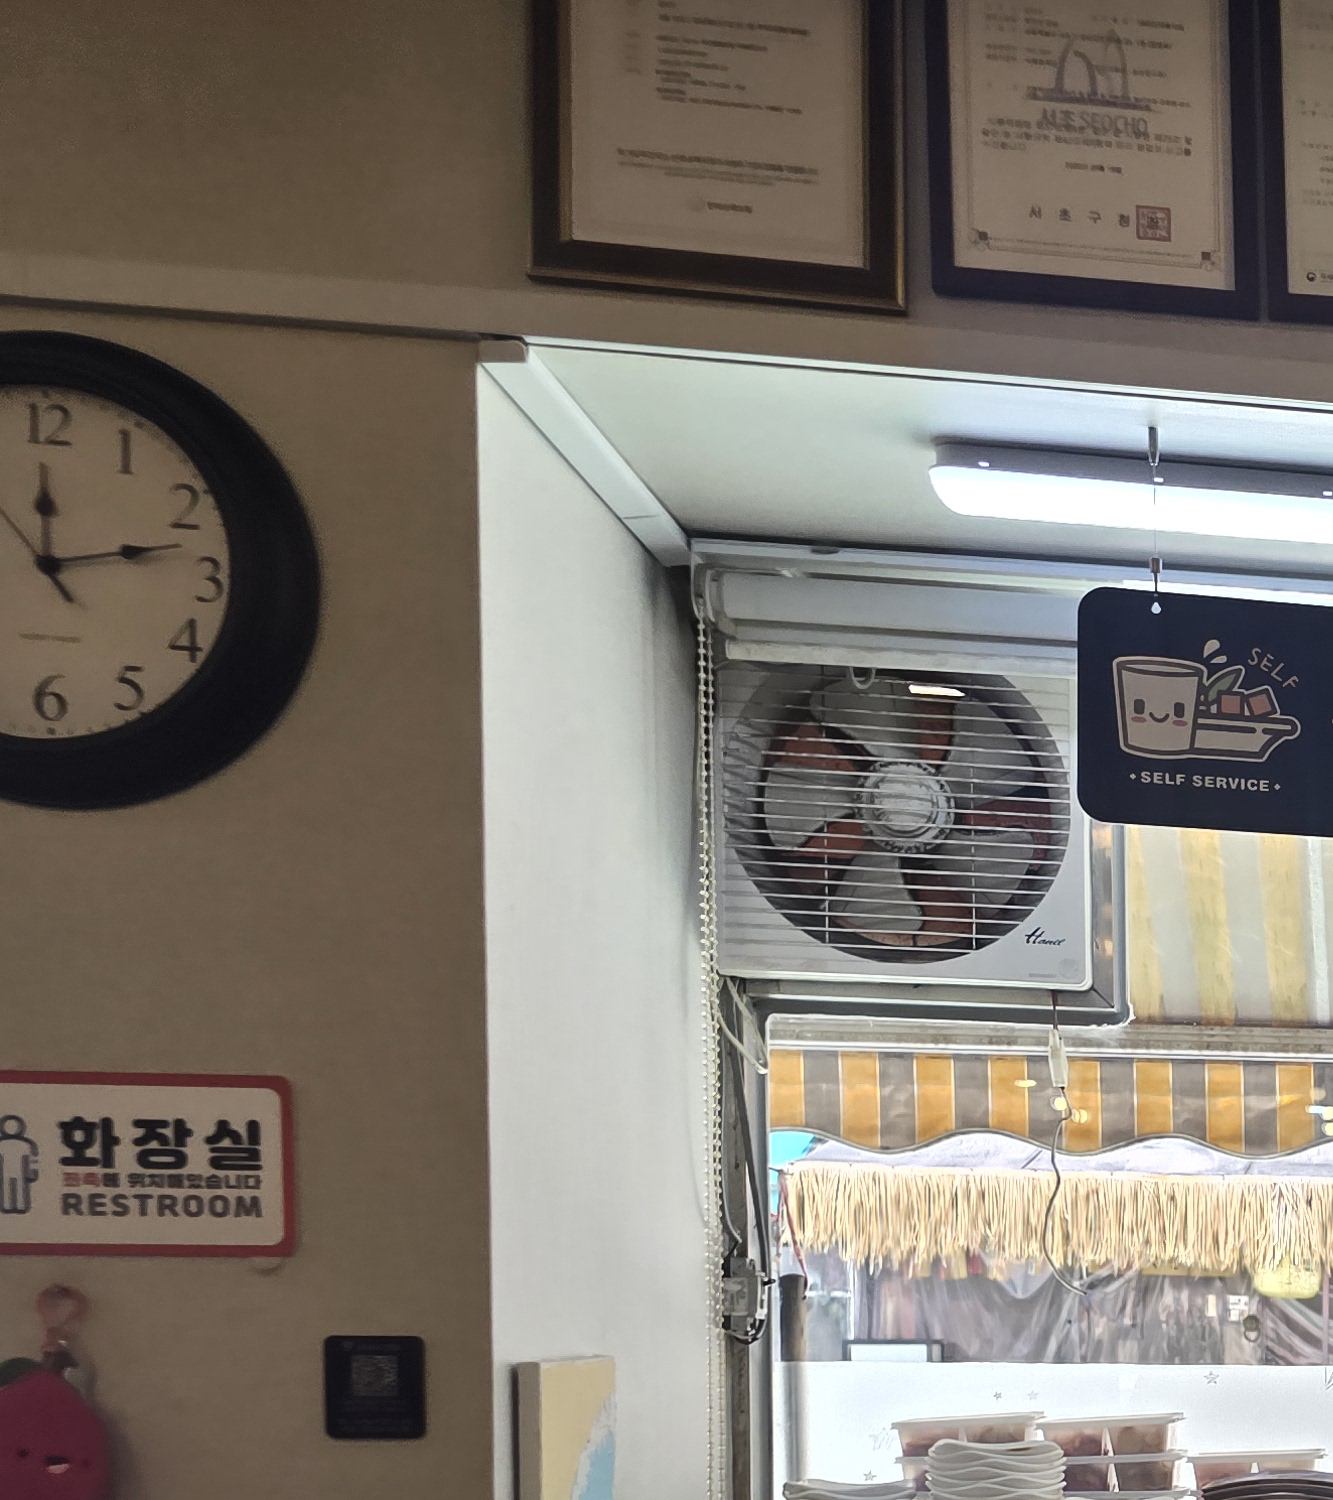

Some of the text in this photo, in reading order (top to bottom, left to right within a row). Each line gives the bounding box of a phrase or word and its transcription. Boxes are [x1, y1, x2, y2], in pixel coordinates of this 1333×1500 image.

[26, 402, 73, 446] 12
[117, 429, 133, 475] 1
[169, 483, 200, 531] 2
[195, 556, 224, 603] 3
[168, 618, 203, 663] 4
[113, 665, 145, 711] 5
[1247, 647, 1300, 690] SELF
[32, 674, 70, 722] 6
[1141, 772, 1270, 792] SELF SERVICE
[58, 1115, 263, 1171] 화장실
[60, 1193, 263, 1218] RESTROOM
